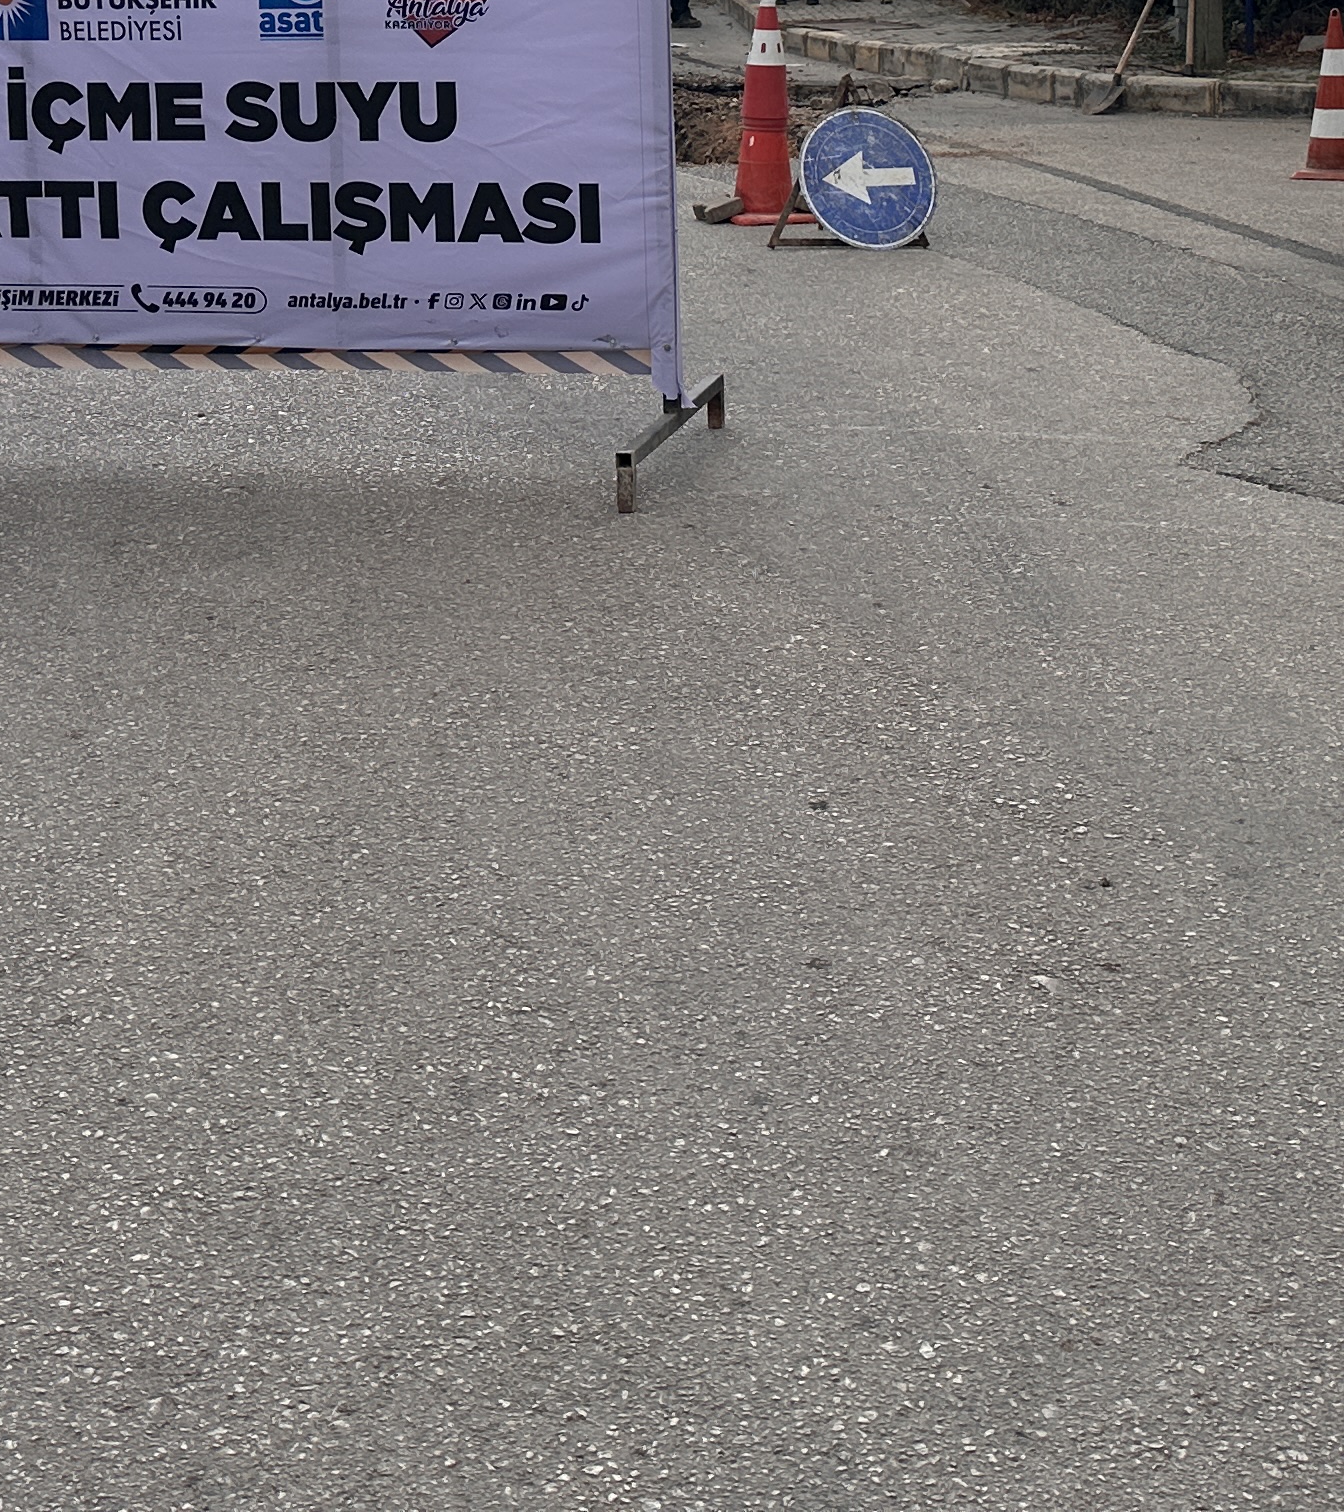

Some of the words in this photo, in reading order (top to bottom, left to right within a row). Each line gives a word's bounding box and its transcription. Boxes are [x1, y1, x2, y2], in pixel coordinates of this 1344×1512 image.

[59, 15, 183, 41] BELEDİYESİ
[259, 10, 325, 33] asat
[384, 20, 452, 30] KAZANIYOR
[7, 66, 206, 154] İÇME
[224, 80, 457, 144] SUYU
[142, 180, 602, 256] ÇALIŞMASI
[162, 291, 199, 308] 444
[203, 292, 227, 309] 94
[231, 292, 257, 309] 20
[287, 292, 408, 312] antalya.bel.tr
